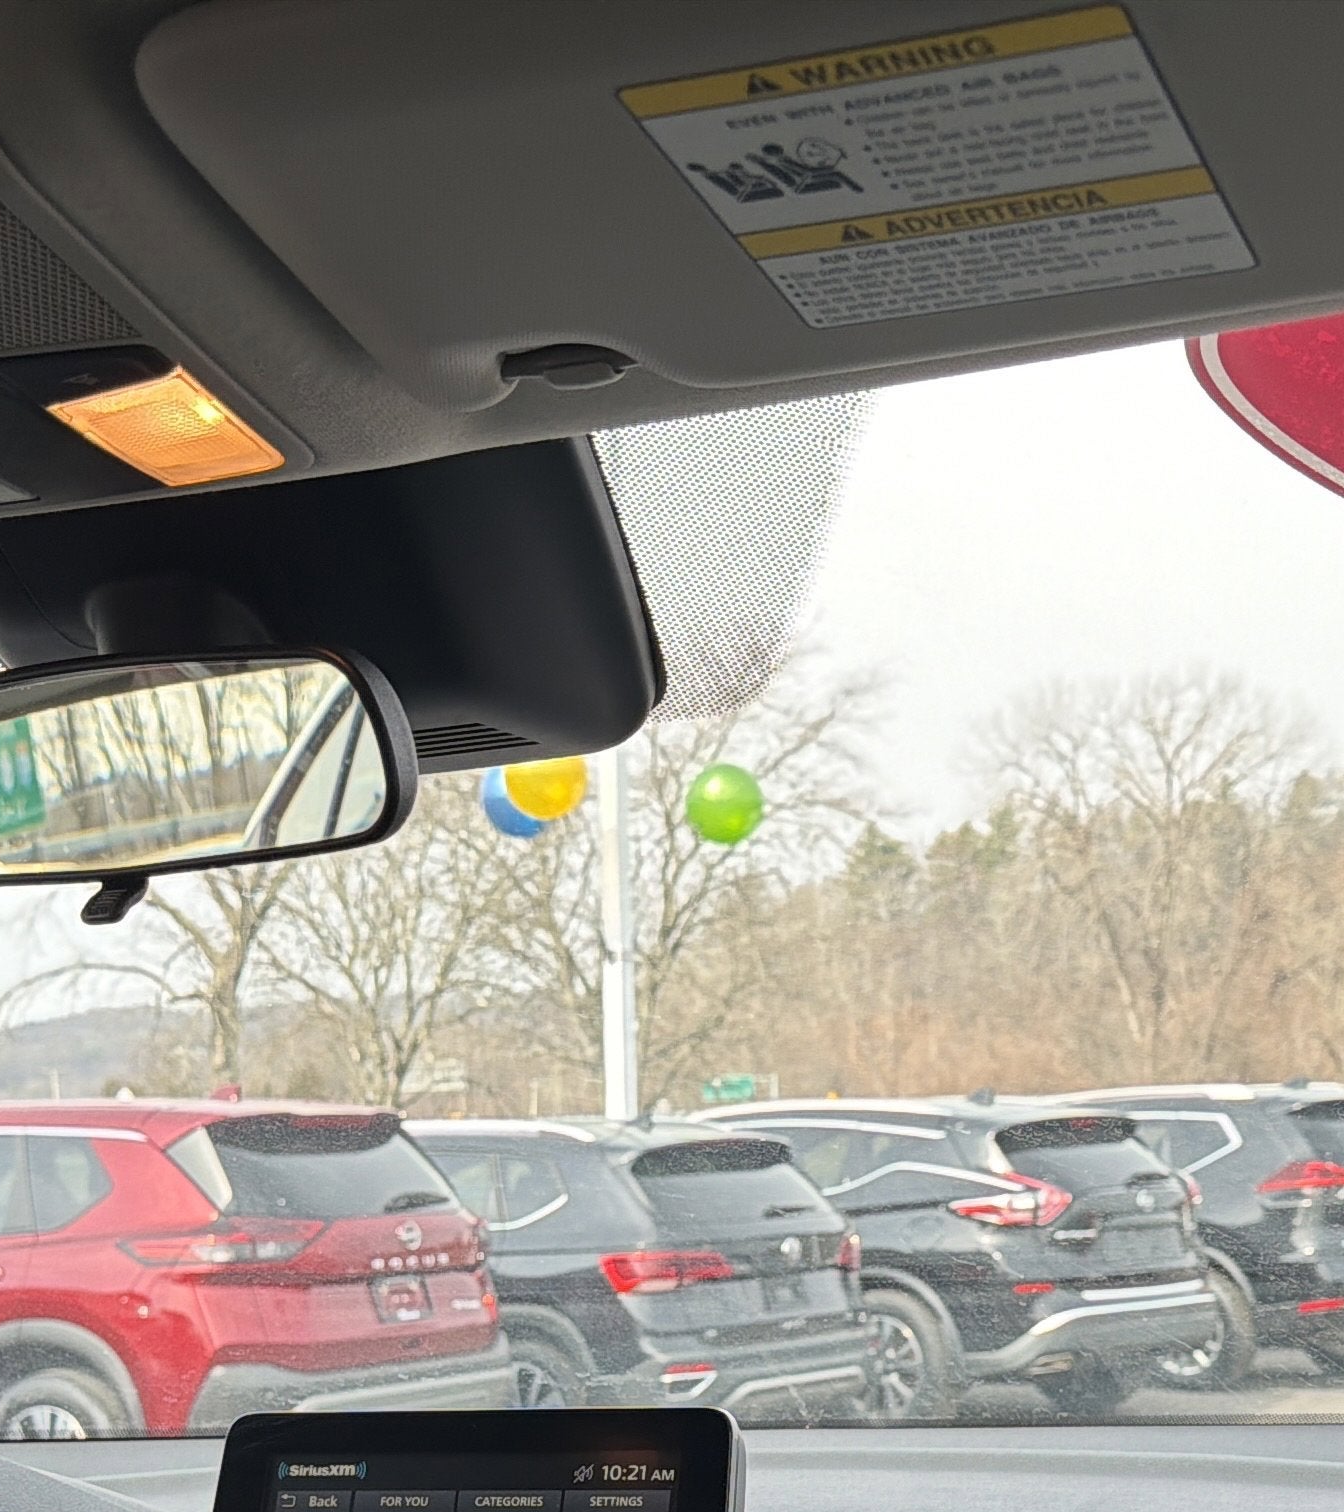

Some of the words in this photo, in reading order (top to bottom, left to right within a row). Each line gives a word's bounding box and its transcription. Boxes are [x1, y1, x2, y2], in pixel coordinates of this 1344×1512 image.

[788, 35, 997, 88] WARNING
[843, 83, 952, 111] ADVANCED
[883, 188, 1110, 239] ADVERTENCIA
[601, 1465, 647, 1482] 10:21
[650, 1469, 675, 1482] AM
[308, 1495, 338, 1508] Back
[379, 1496, 403, 1507] FOR
[404, 1496, 429, 1507] YOU
[474, 1496, 544, 1507] CATEGORIES
[589, 1496, 644, 1507] SETTINGS
